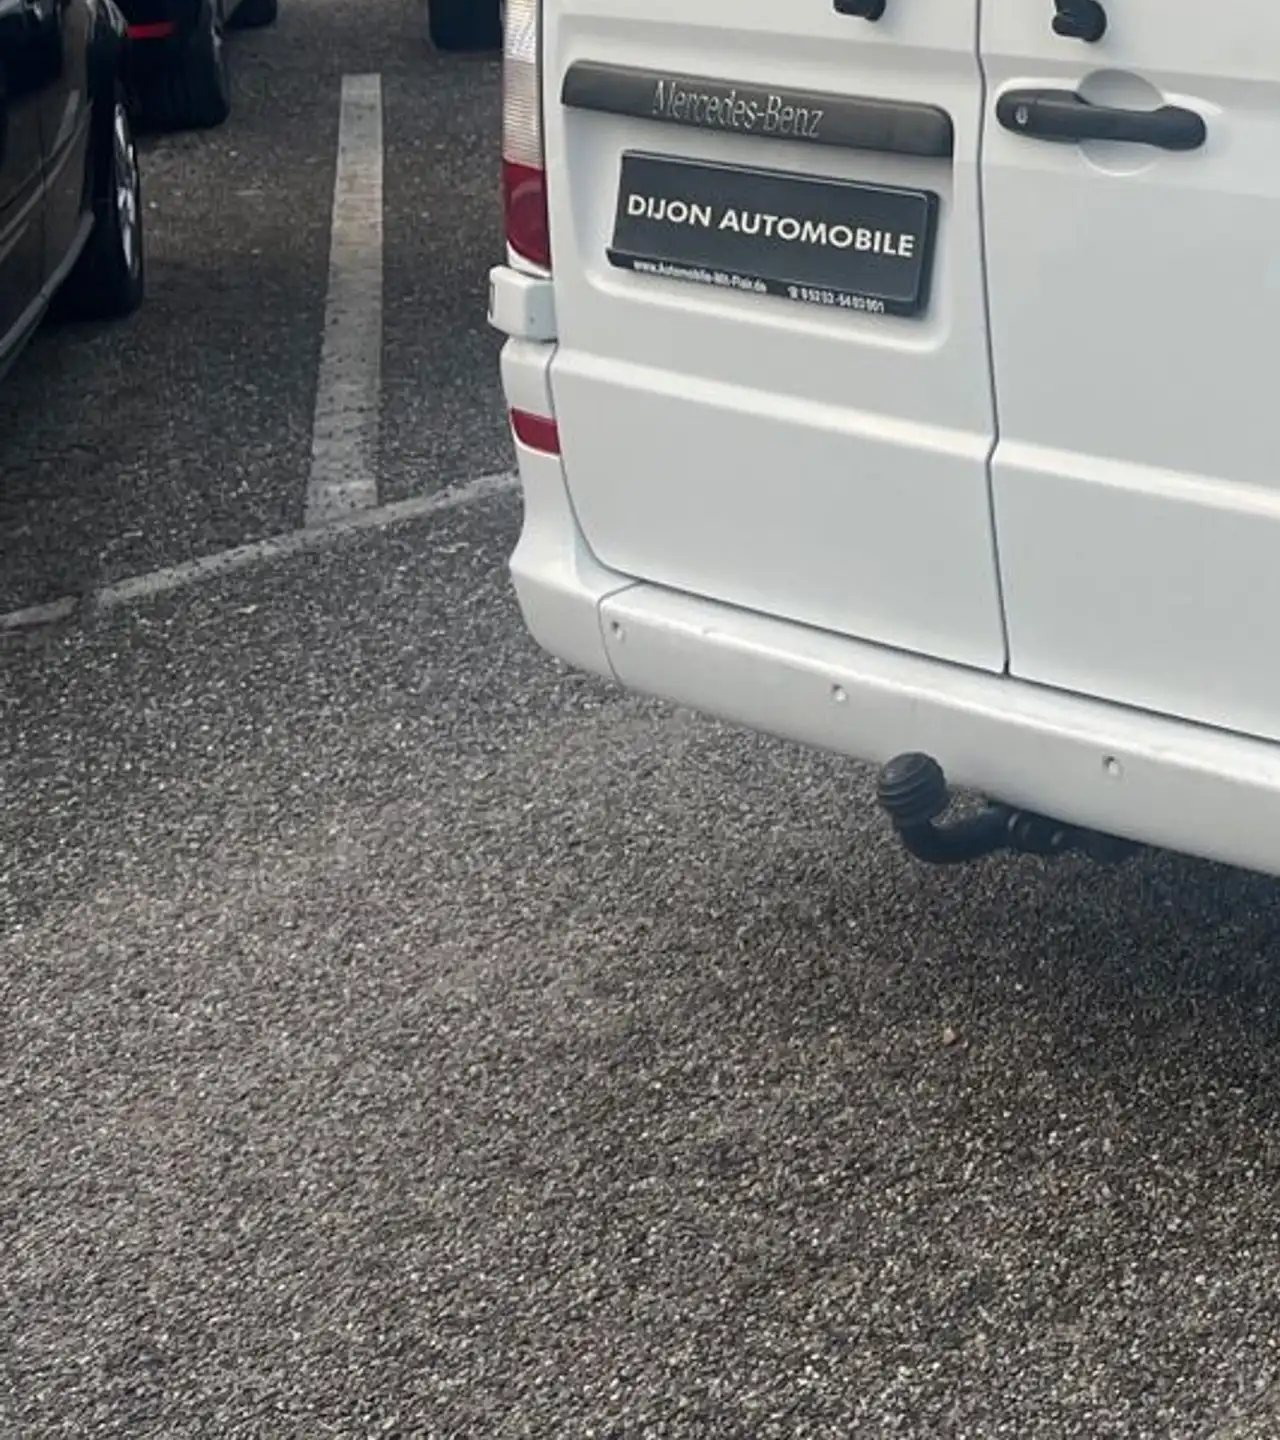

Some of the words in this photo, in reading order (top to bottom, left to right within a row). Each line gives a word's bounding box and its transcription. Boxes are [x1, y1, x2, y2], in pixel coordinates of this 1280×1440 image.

[652, 79, 824, 138] Mercedes-Benz
[627, 194, 712, 227] DIJON
[718, 209, 916, 258] AUTOMOBILE
